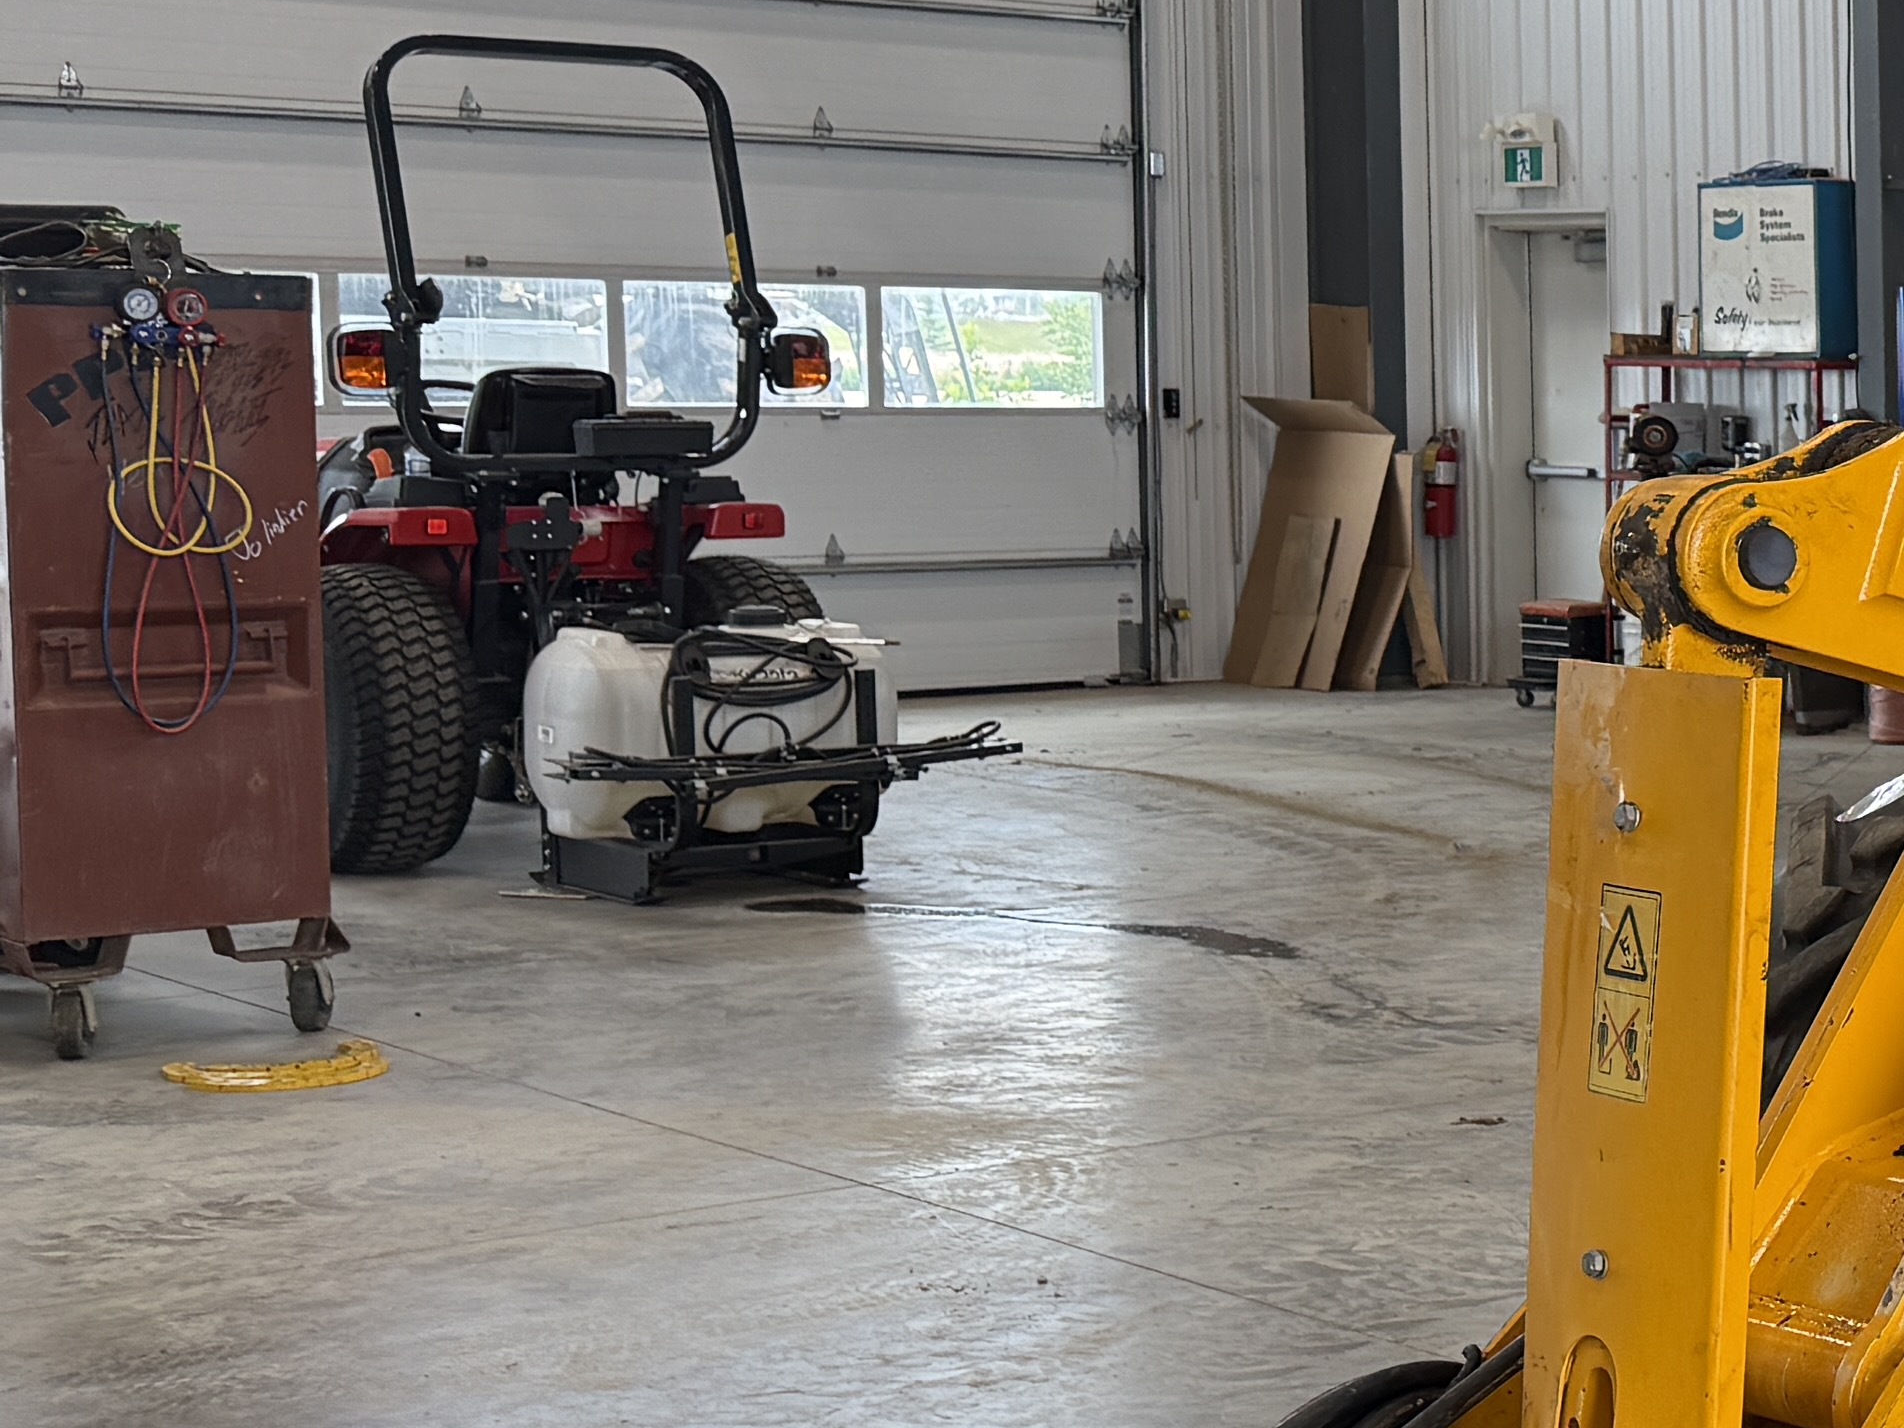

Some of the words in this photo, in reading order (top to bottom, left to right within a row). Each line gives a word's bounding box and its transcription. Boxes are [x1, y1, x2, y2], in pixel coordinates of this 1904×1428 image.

[1759, 207, 1784, 217] Brake
[1759, 219, 1792, 231] System
[1759, 232, 1806, 244] Specialists
[1714, 305, 1748, 331] Safety
